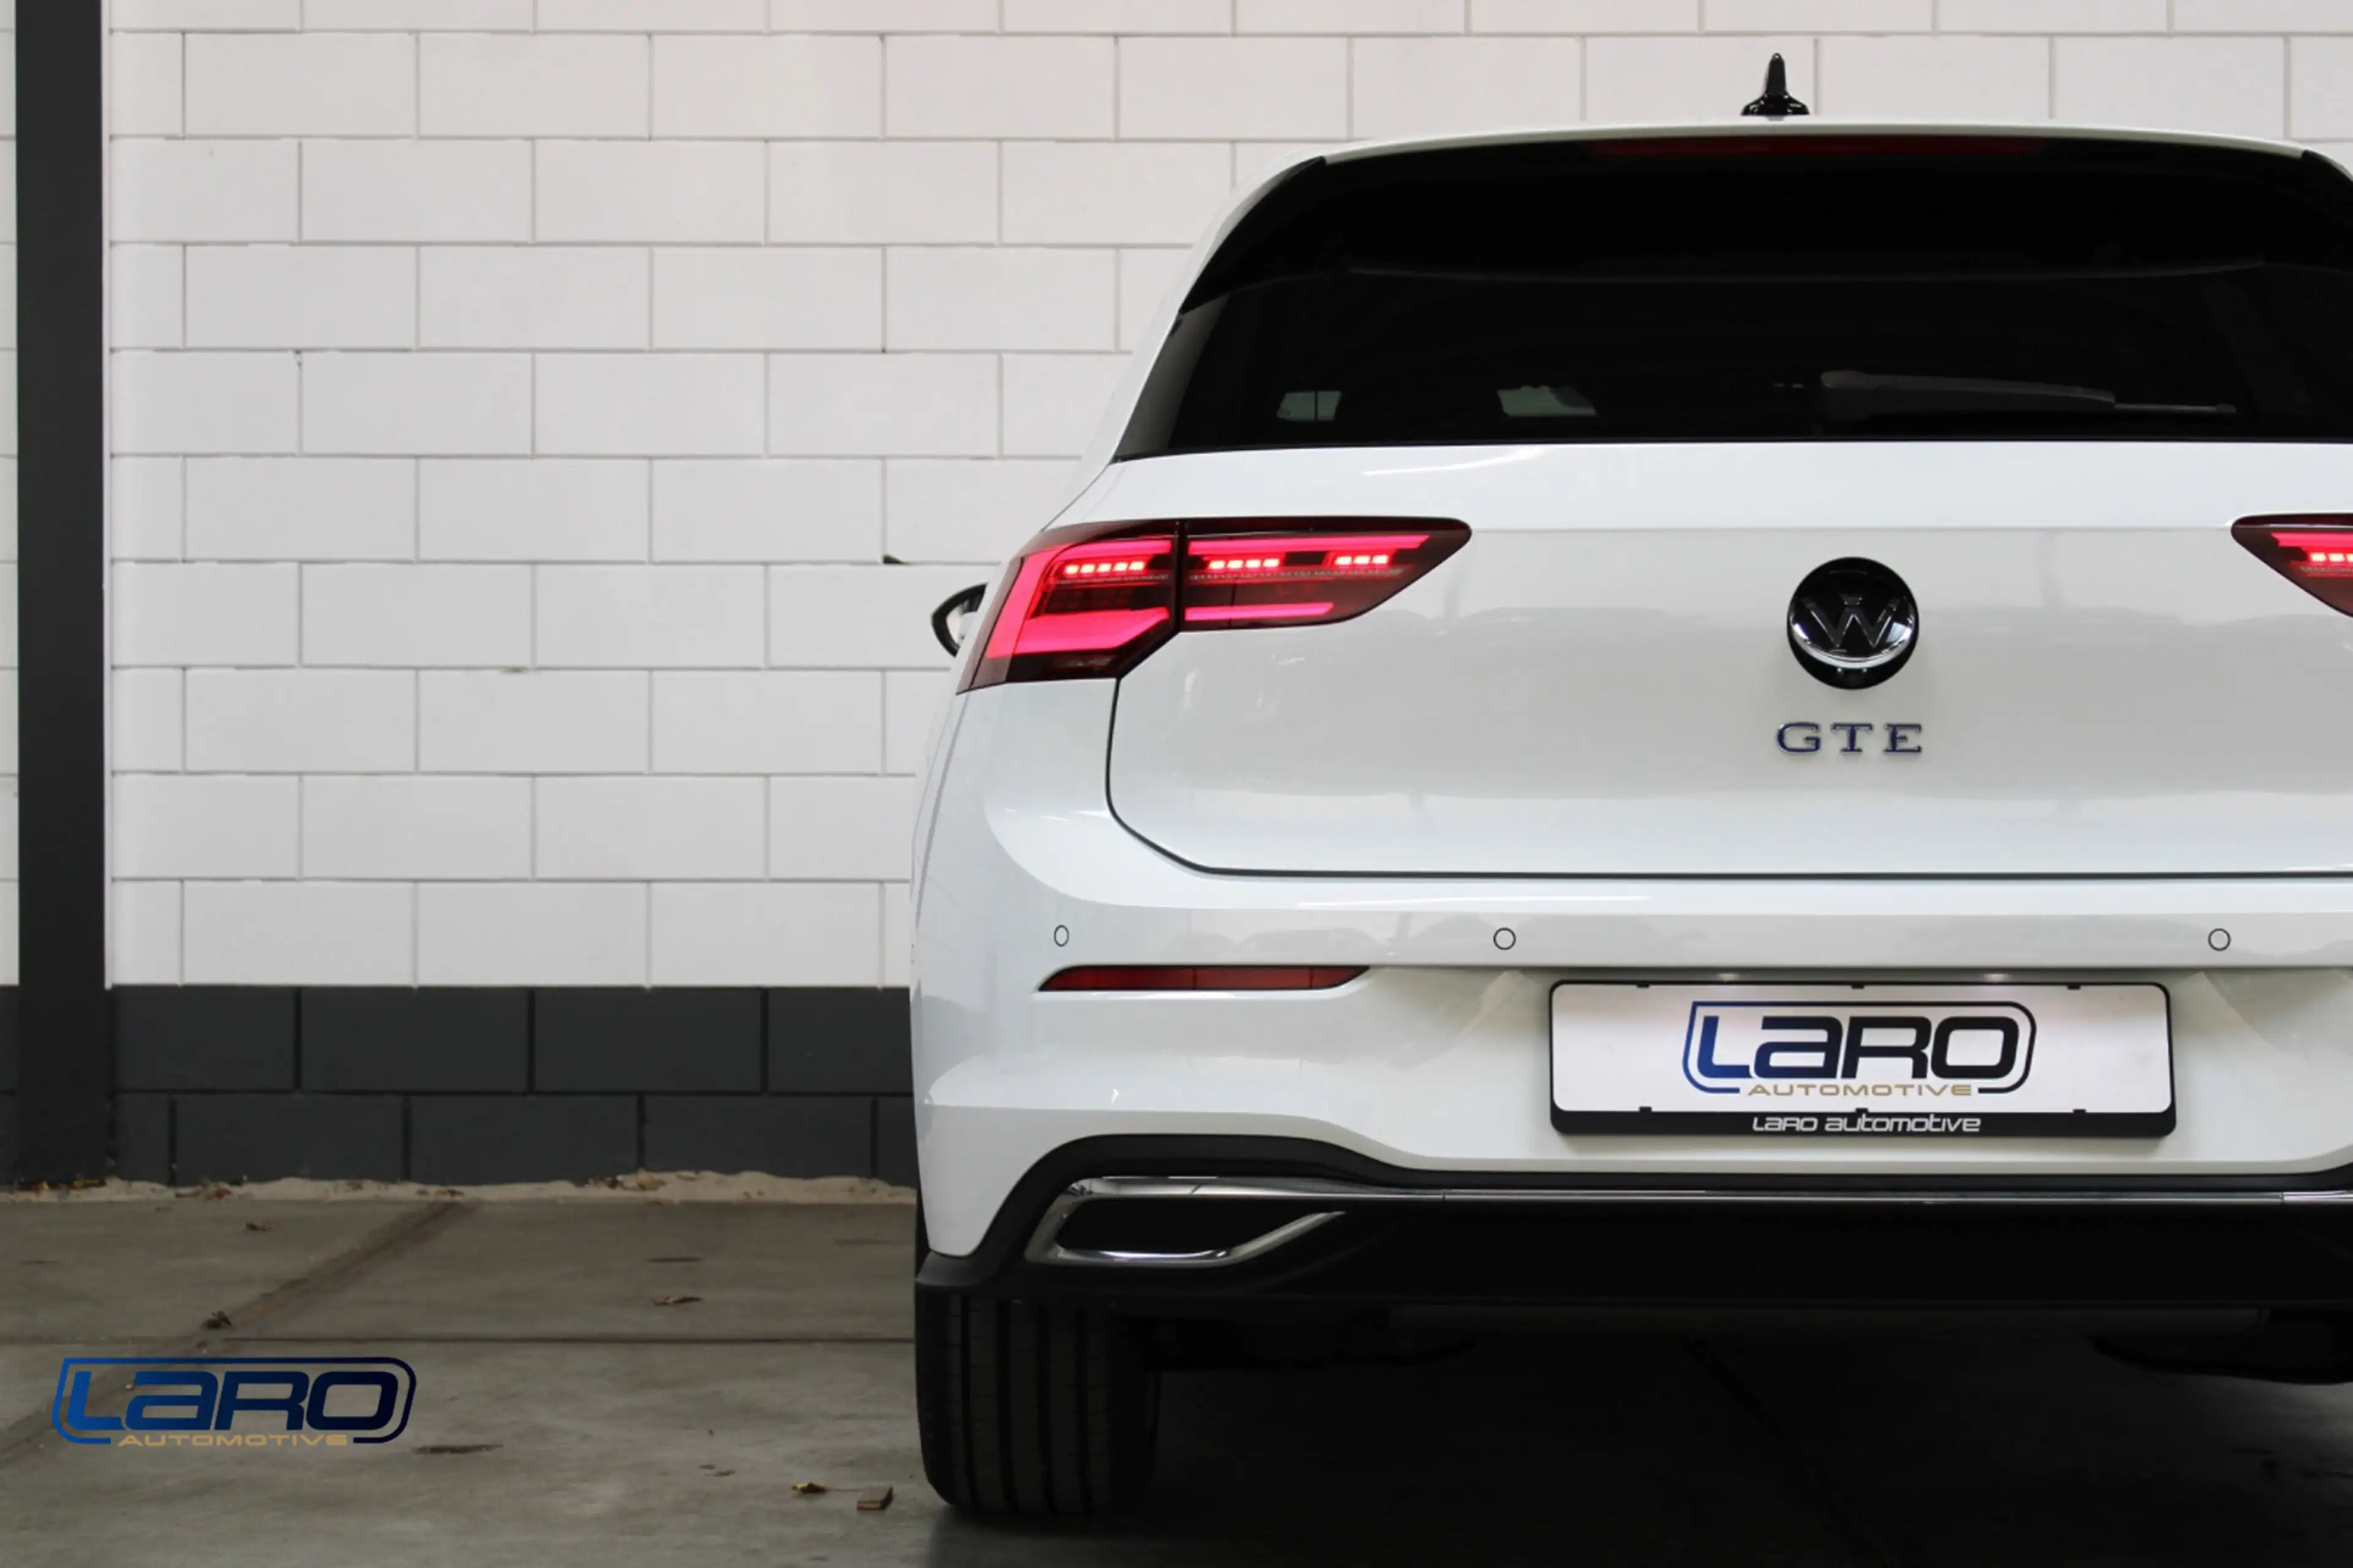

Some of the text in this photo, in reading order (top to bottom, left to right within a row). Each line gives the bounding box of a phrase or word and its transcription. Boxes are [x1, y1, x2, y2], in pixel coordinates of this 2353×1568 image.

[1776, 721, 1923, 753] GTE
[1747, 1083, 1972, 1096] AUTOMOTIVE
[1824, 1113, 1982, 1132] automotive
